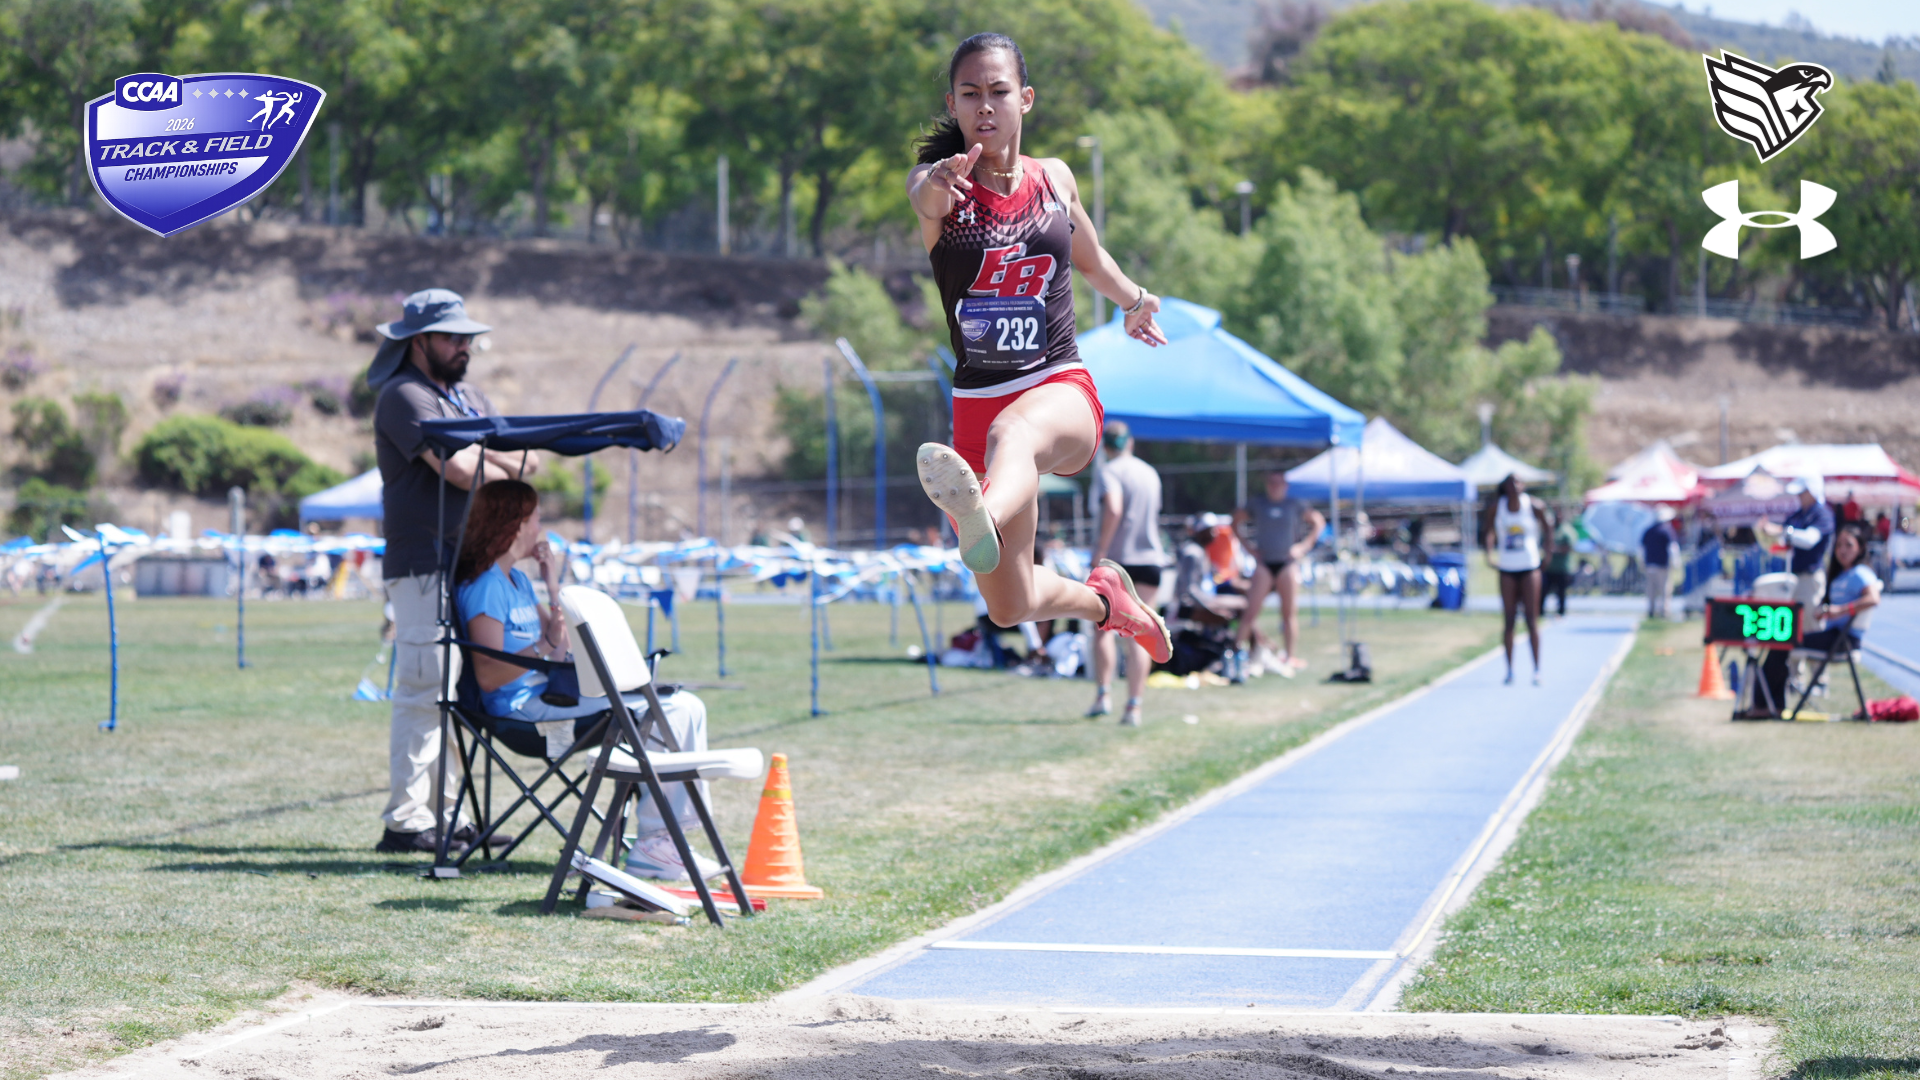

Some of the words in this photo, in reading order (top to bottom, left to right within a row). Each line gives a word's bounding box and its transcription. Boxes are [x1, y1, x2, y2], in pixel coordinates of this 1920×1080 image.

[967, 242, 1056, 297] EB
[996, 317, 1039, 351] 232
[1735, 604, 1793, 642] 7:30
